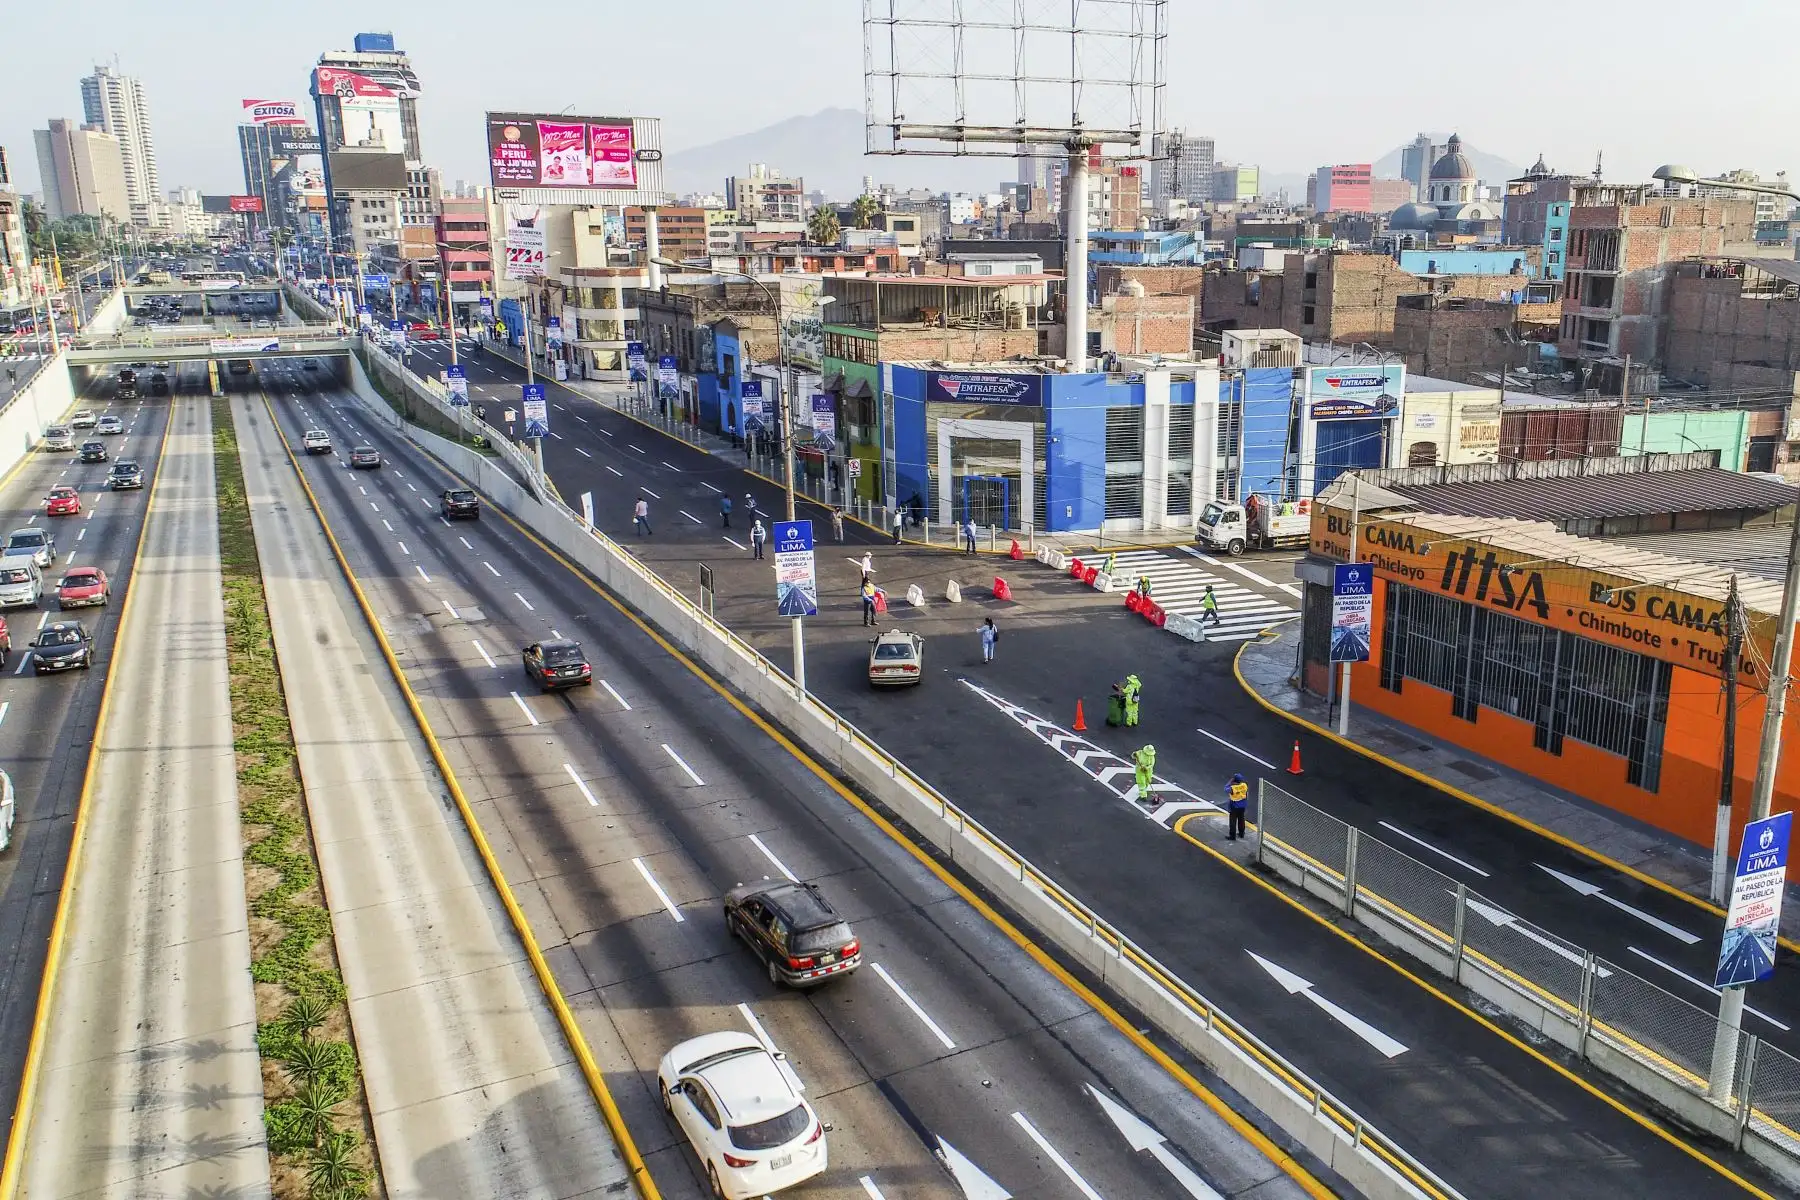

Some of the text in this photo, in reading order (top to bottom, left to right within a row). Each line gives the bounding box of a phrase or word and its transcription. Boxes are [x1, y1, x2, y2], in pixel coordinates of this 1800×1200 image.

[254, 107, 295, 116] EXITOSA
[961, 384, 1009, 394] EMTRAFESA
[1341, 379, 1377, 387] EMTRAFESA
[1460, 426, 1478, 442] SANTA
[781, 543, 806, 551] LIMA
[1365, 525, 1415, 555] CAMA
[1370, 553, 1425, 581] Chiclayo
[1341, 586, 1366, 594] LIMA
[1590, 581, 1722, 637] BUS CAMA
[1339, 616, 1366, 624] ENTREGADA
[1579, 610, 1661, 647] Chimbote
[1746, 855, 1777, 872] LIMA
[1745, 880, 1765, 892] PASEO
[1766, 879, 1774, 888] DE
[1775, 877, 1783, 886] LA
[1736, 907, 1773, 924] ENTREGADA
[1747, 903, 1765, 913] OBRA
